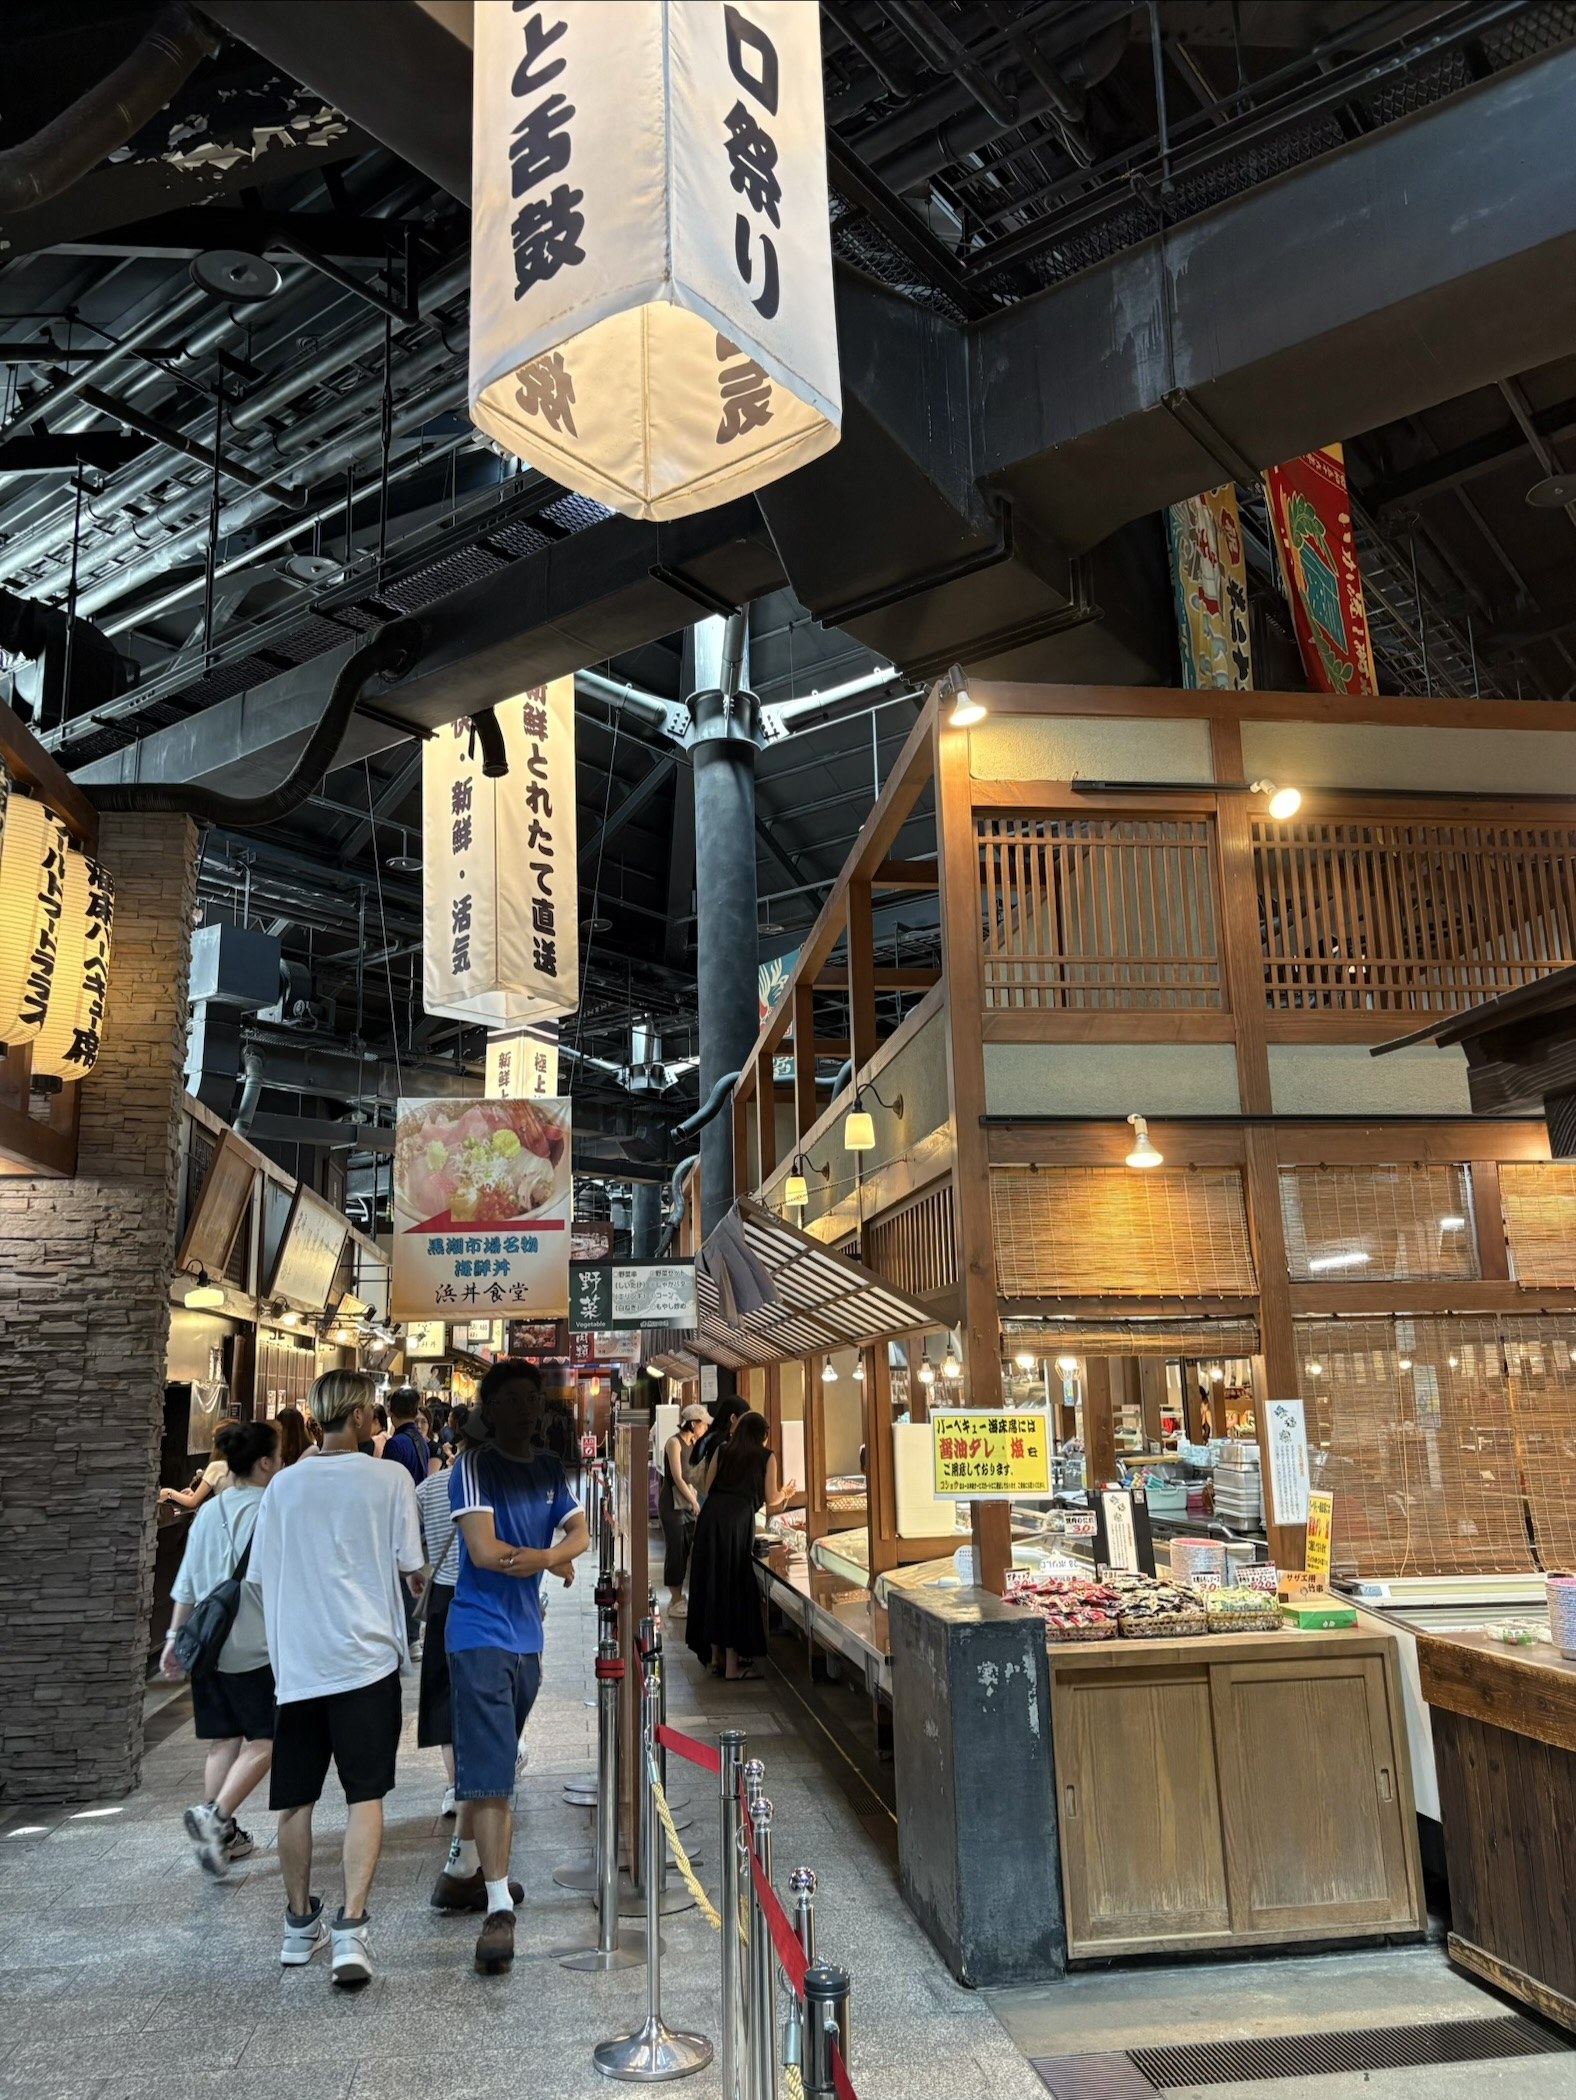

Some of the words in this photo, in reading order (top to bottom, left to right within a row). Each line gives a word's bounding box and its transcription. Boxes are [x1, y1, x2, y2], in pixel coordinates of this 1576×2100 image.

[509, 0, 586, 302] と舌鼓
[533, 1052, 547, 1099] 極上
[427, 1236, 539, 1256] 黒潮市場名物
[454, 1258, 511, 1278] 海鮮丼
[578, 1271, 602, 1320] 野菜
[575, 1321, 606, 1329] Vegetable
[1286, 1573, 1316, 1583] サザエ用
[1307, 1583, 1324, 1593] 竹串
